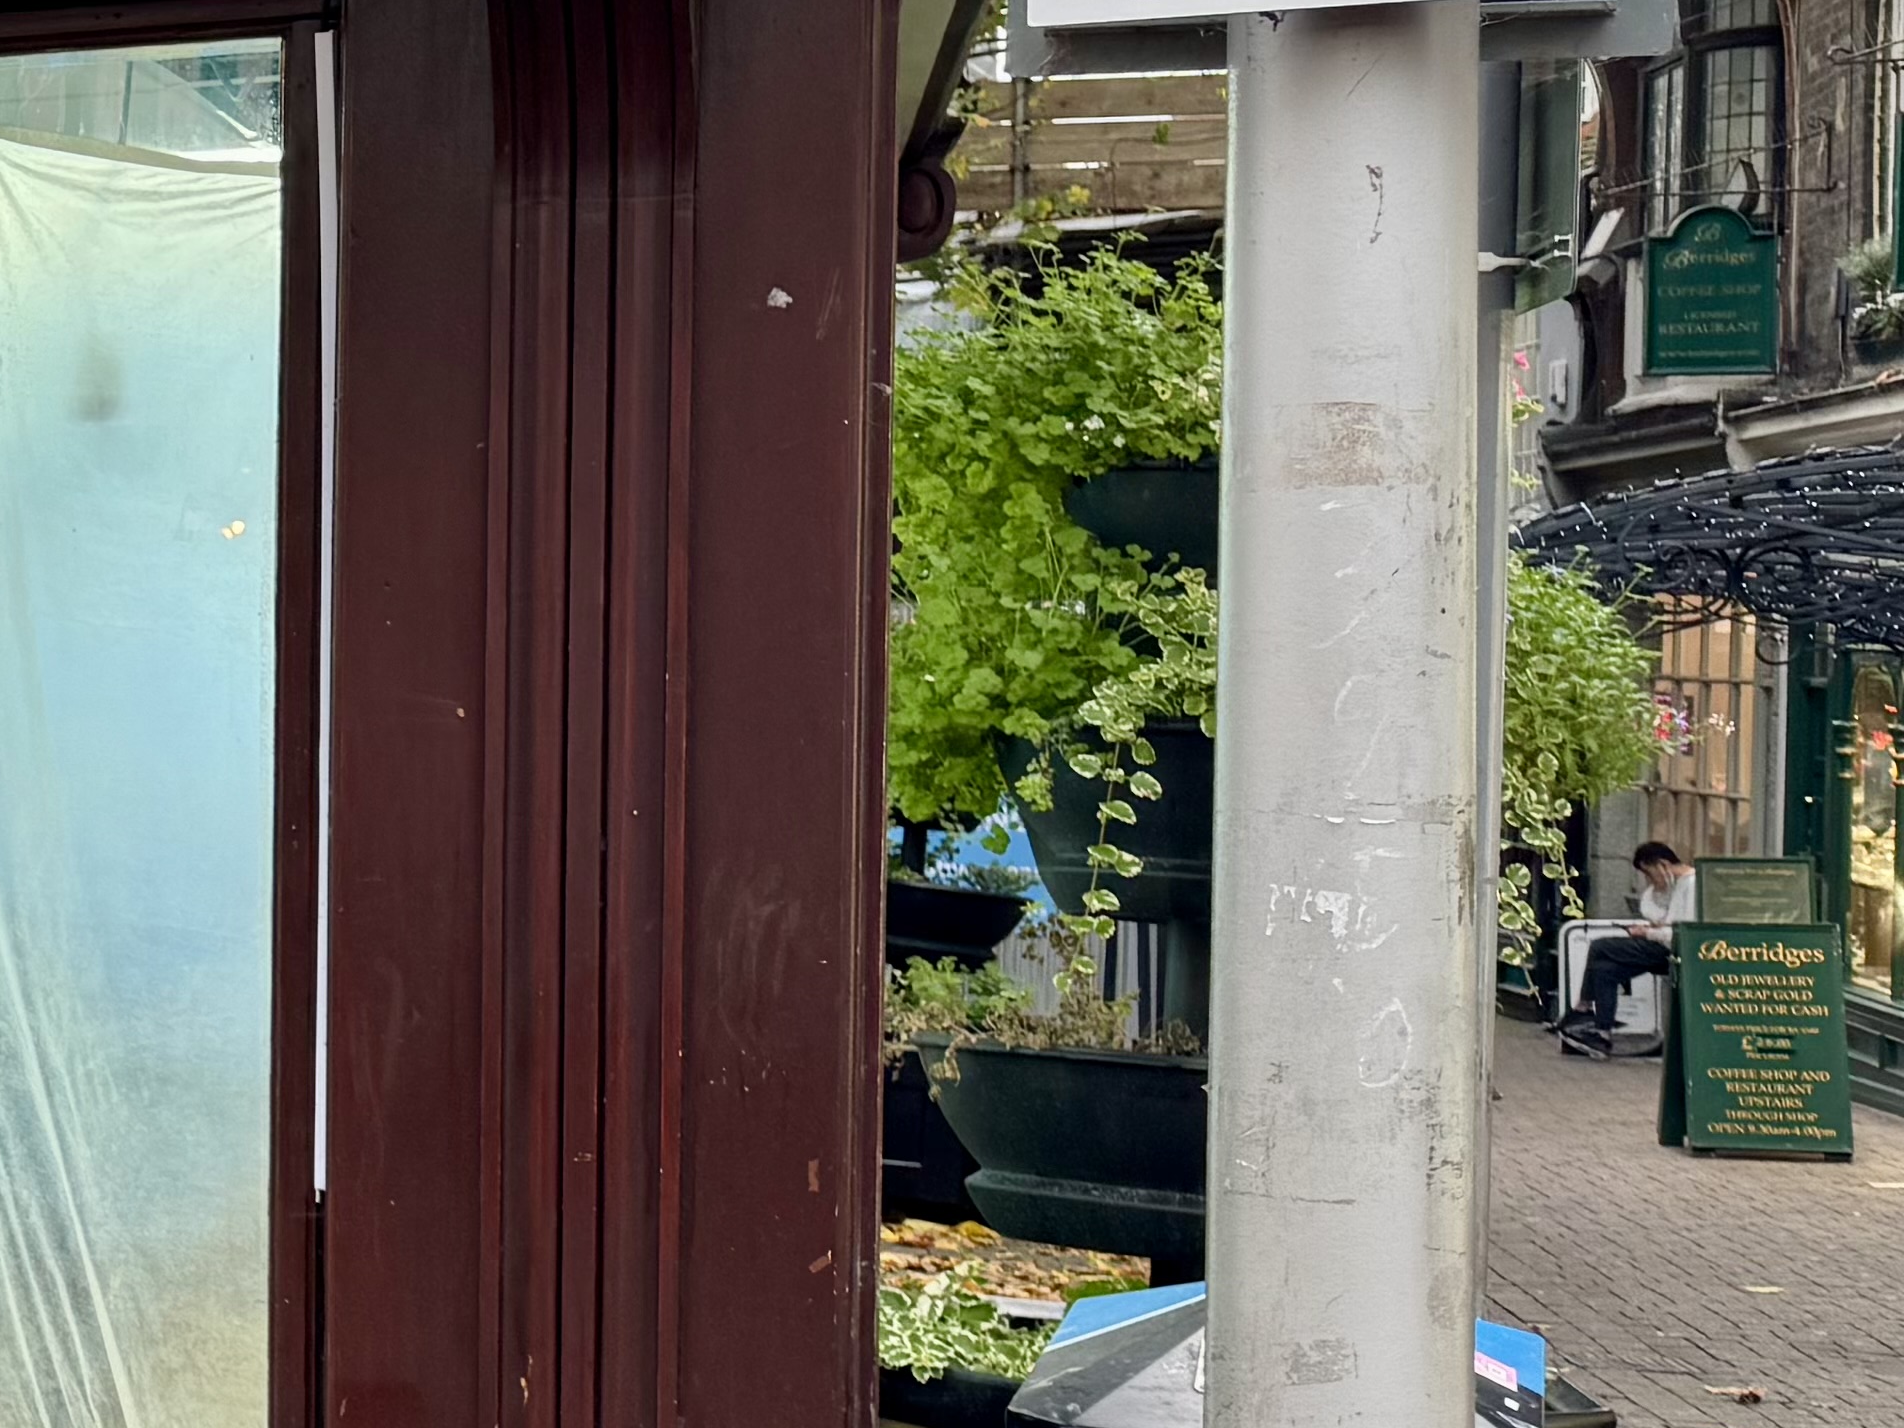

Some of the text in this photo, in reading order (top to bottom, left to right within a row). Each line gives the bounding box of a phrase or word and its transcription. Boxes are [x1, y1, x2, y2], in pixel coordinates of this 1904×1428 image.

[1658, 321, 1760, 335] RESTAURANT
[1698, 940, 1826, 969] Berridges
[1709, 974, 1815, 988] OLD JEWELLERY
[1728, 989, 1771, 1001] SCRAP
[1773, 990, 1814, 1002] GOLD
[1700, 1003, 1830, 1017] WANTED FOR CASH
[1706, 1067, 1831, 1082] COFFEE SHOP AND
[1725, 1082, 1814, 1095] RESTAURANT
[1738, 1096, 1803, 1109] UPSTAIRS
[1725, 1109, 1819, 1122] THROUGH SHOP
[1707, 1122, 1745, 1134] OPEN
